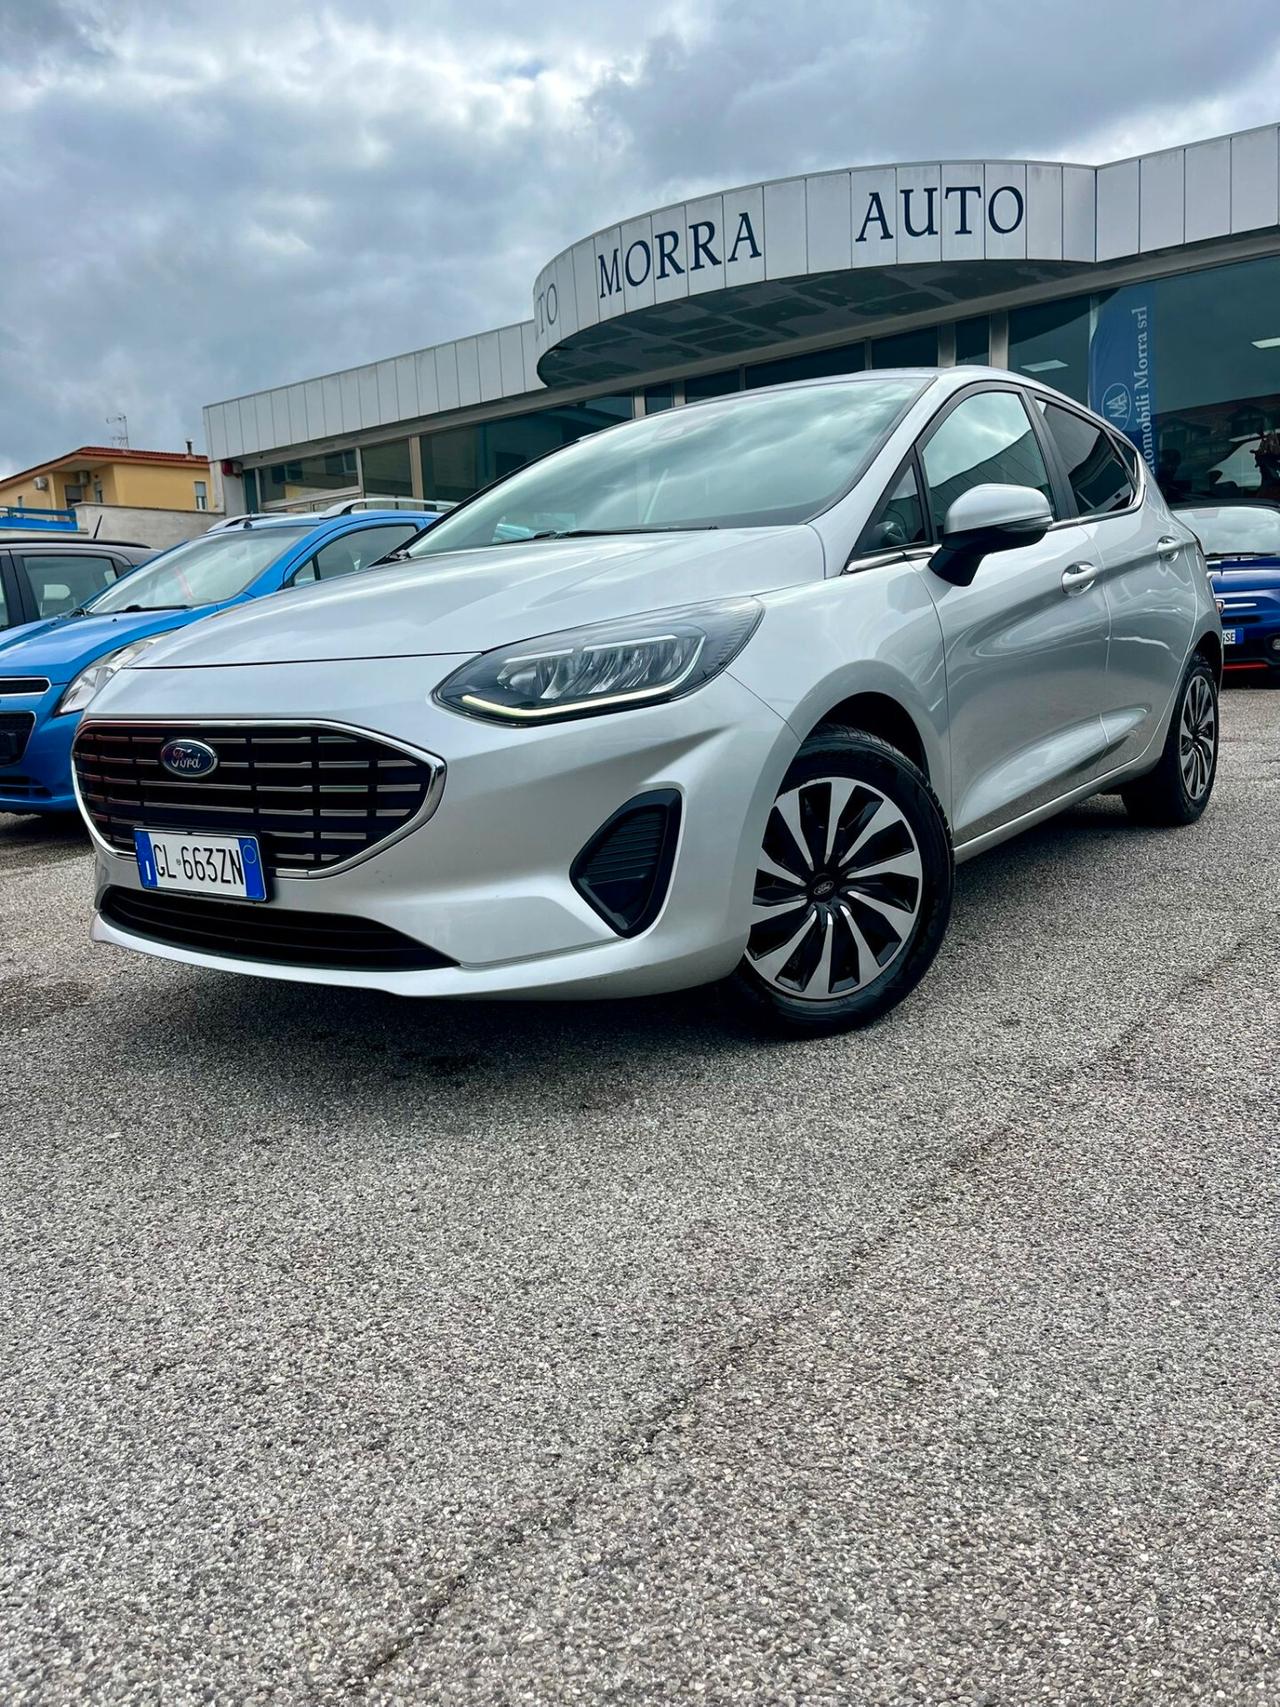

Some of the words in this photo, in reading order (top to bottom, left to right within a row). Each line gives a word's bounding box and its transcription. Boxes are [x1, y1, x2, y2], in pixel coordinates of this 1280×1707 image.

[598, 212, 762, 299] MORRA
[855, 185, 1024, 243] AUTO
[536, 284, 558, 335] TO
[1131, 306, 1147, 329] srl
[1134, 331, 1149, 390] Morra
[171, 747, 202, 769] Ford
